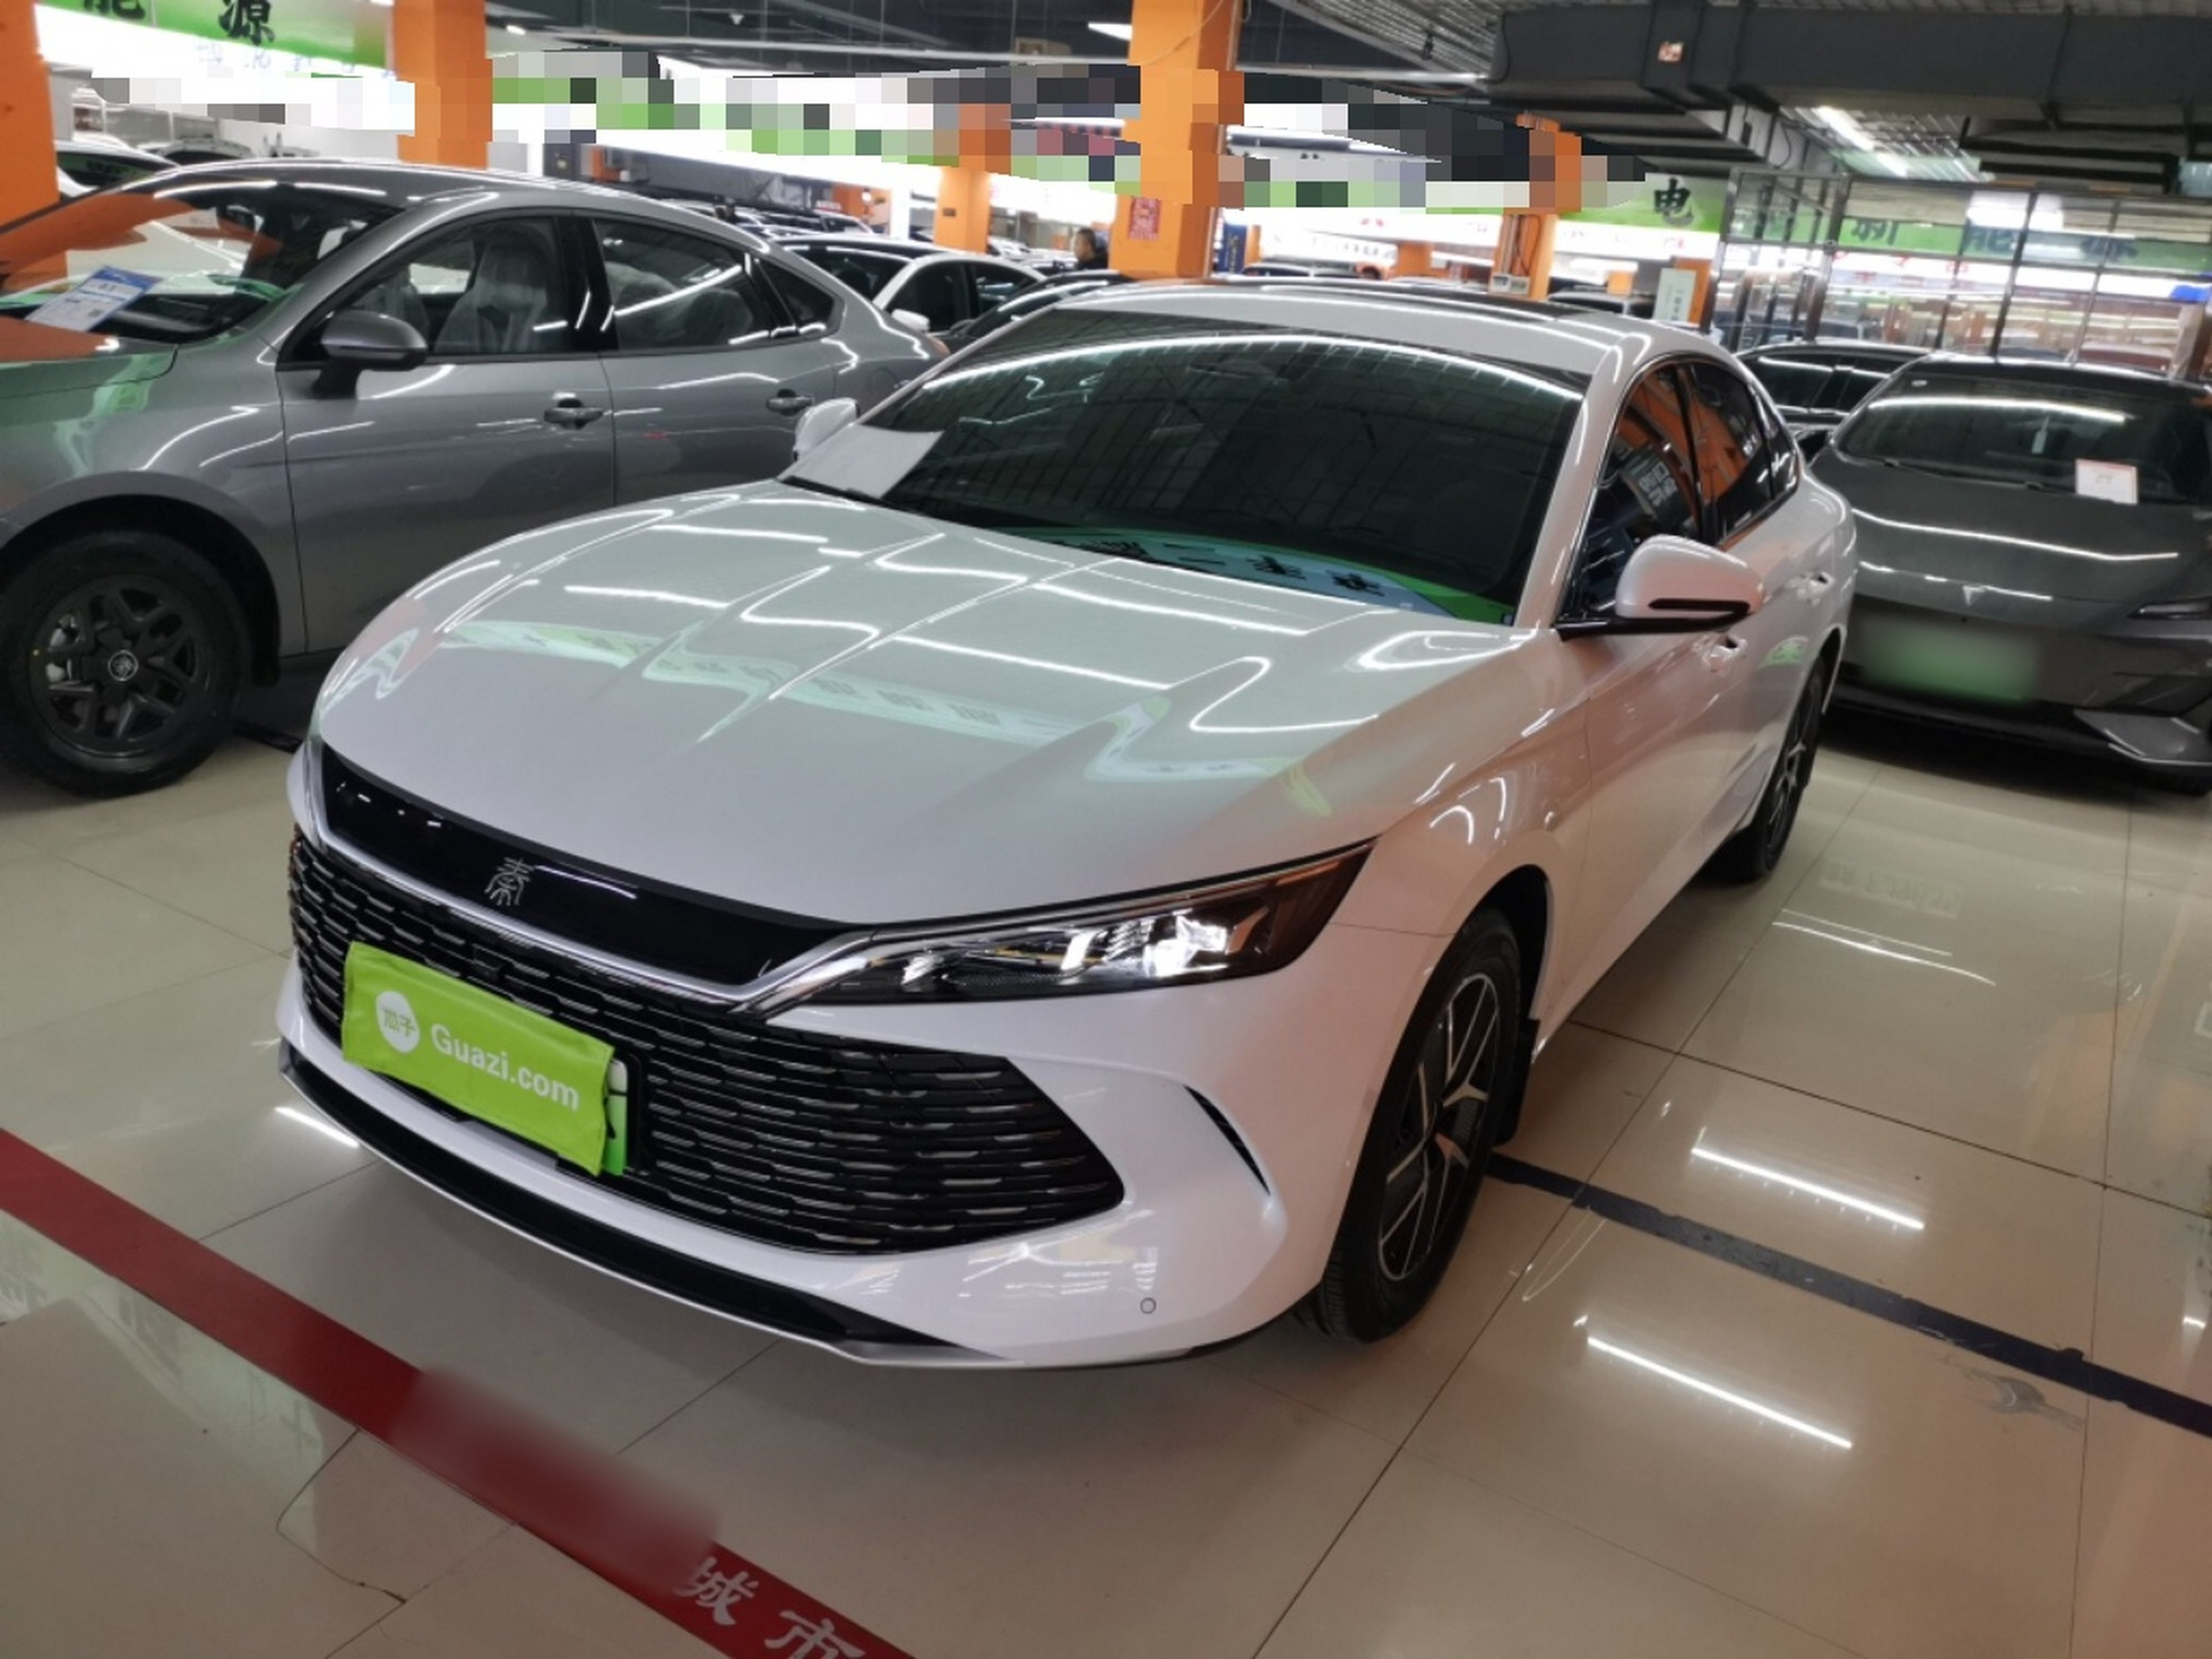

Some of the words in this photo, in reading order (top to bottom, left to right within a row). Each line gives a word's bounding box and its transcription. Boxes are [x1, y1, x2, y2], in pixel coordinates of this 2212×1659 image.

[1654, 177, 1695, 226] 电
[484, 857, 535, 907] 秦
[431, 1024, 579, 1112] Guazi.com
